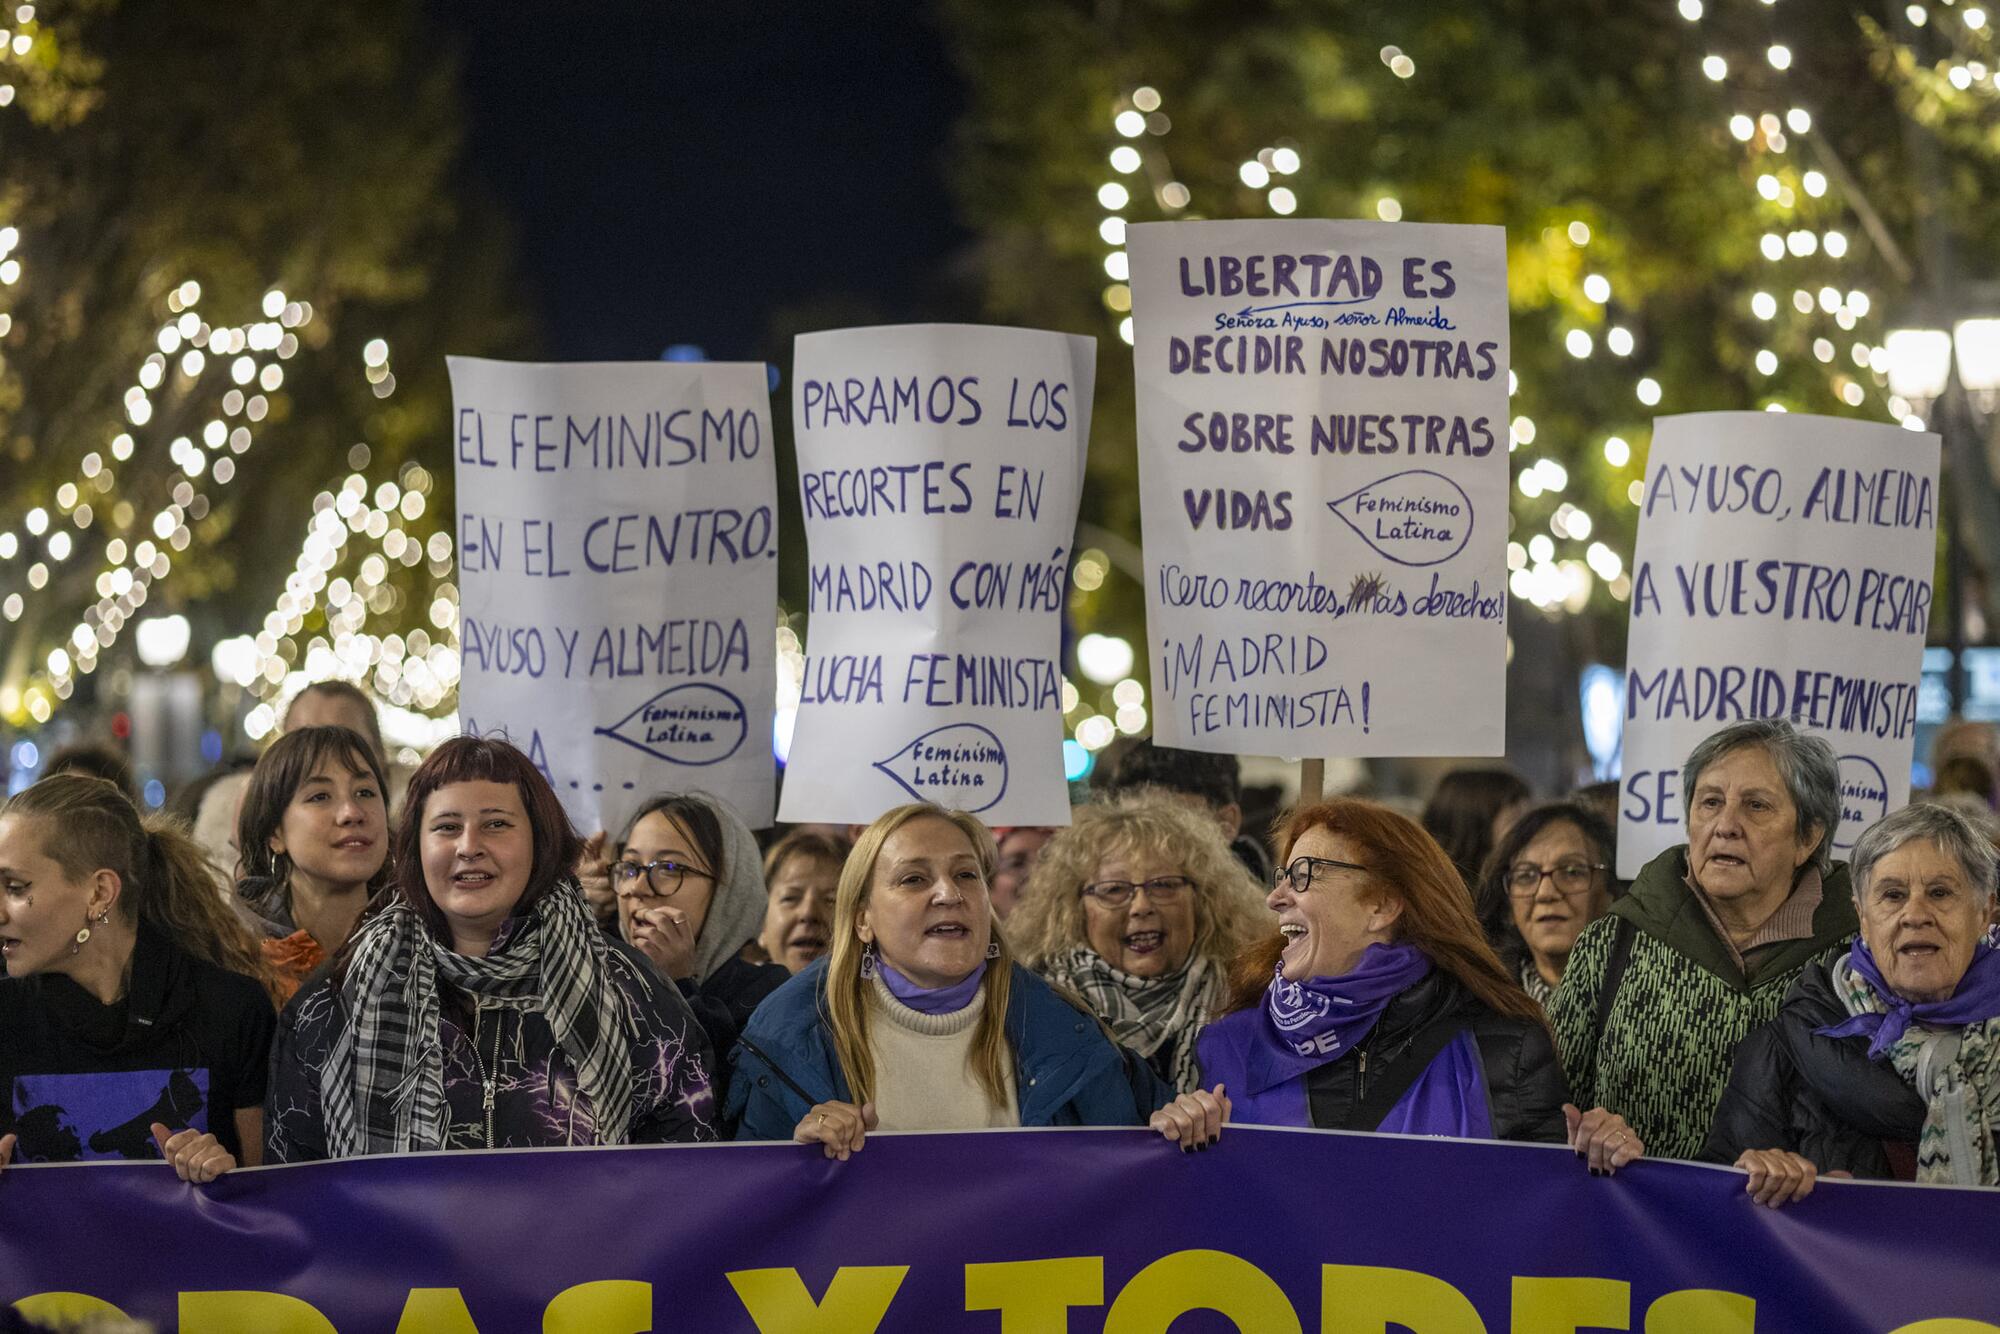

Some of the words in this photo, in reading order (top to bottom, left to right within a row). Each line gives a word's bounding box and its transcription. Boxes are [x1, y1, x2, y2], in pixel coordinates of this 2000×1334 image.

[1180, 254, 1383, 298] LIBERTAD
[1403, 257, 1457, 299] ES
[1214, 311, 1279, 331] Señora
[1282, 310, 1330, 333] Ayuso,
[1333, 310, 1381, 327] señor
[1385, 305, 1457, 331] Almeida
[1169, 334, 1307, 375] DECIDIR
[1320, 339, 1499, 381] NOSOTRAS
[804, 376, 982, 429] PARAMOS
[1007, 378, 1068, 432] LOS
[459, 409, 498, 467] EL
[511, 408, 760, 472] FEMINISMO
[1177, 412, 1295, 455] SOBRE
[1310, 414, 1495, 457] NUESTRAS
[803, 461, 973, 520] RECORTES
[994, 465, 1044, 522] EN
[1183, 488, 1293, 531] VIDAS
[1355, 492, 1460, 517] Feminismo
[1647, 463, 1791, 522] AYUSO,
[1802, 467, 1933, 529] ALMEIDA
[461, 514, 503, 573] EN
[523, 520, 570, 577] EL
[583, 505, 777, 574] CENTRO.
[1375, 517, 1454, 541] Latina
[810, 561, 932, 613] MADRID
[949, 562, 1013, 611] CON
[1018, 546, 1065, 613] MÁS
[1237, 571, 1347, 619] recortes,
[1634, 562, 1662, 617] A
[1675, 560, 1850, 624] VUESTRO
[1853, 568, 1932, 635] PESAR
[461, 617, 547, 678] AYUSO
[555, 627, 579, 678] Y
[589, 618, 750, 678] ALMEIDA
[1163, 634, 1328, 700] ¡MADRID
[801, 655, 884, 705] LUCHA
[903, 653, 1060, 711] FEMINISTA
[1190, 681, 1370, 735] FEMINISTA!
[1628, 666, 1786, 722] MADRID
[1791, 669, 1917, 740] FEMINISTA
[646, 725, 714, 744] Latina
[913, 764, 984, 786] Latina
